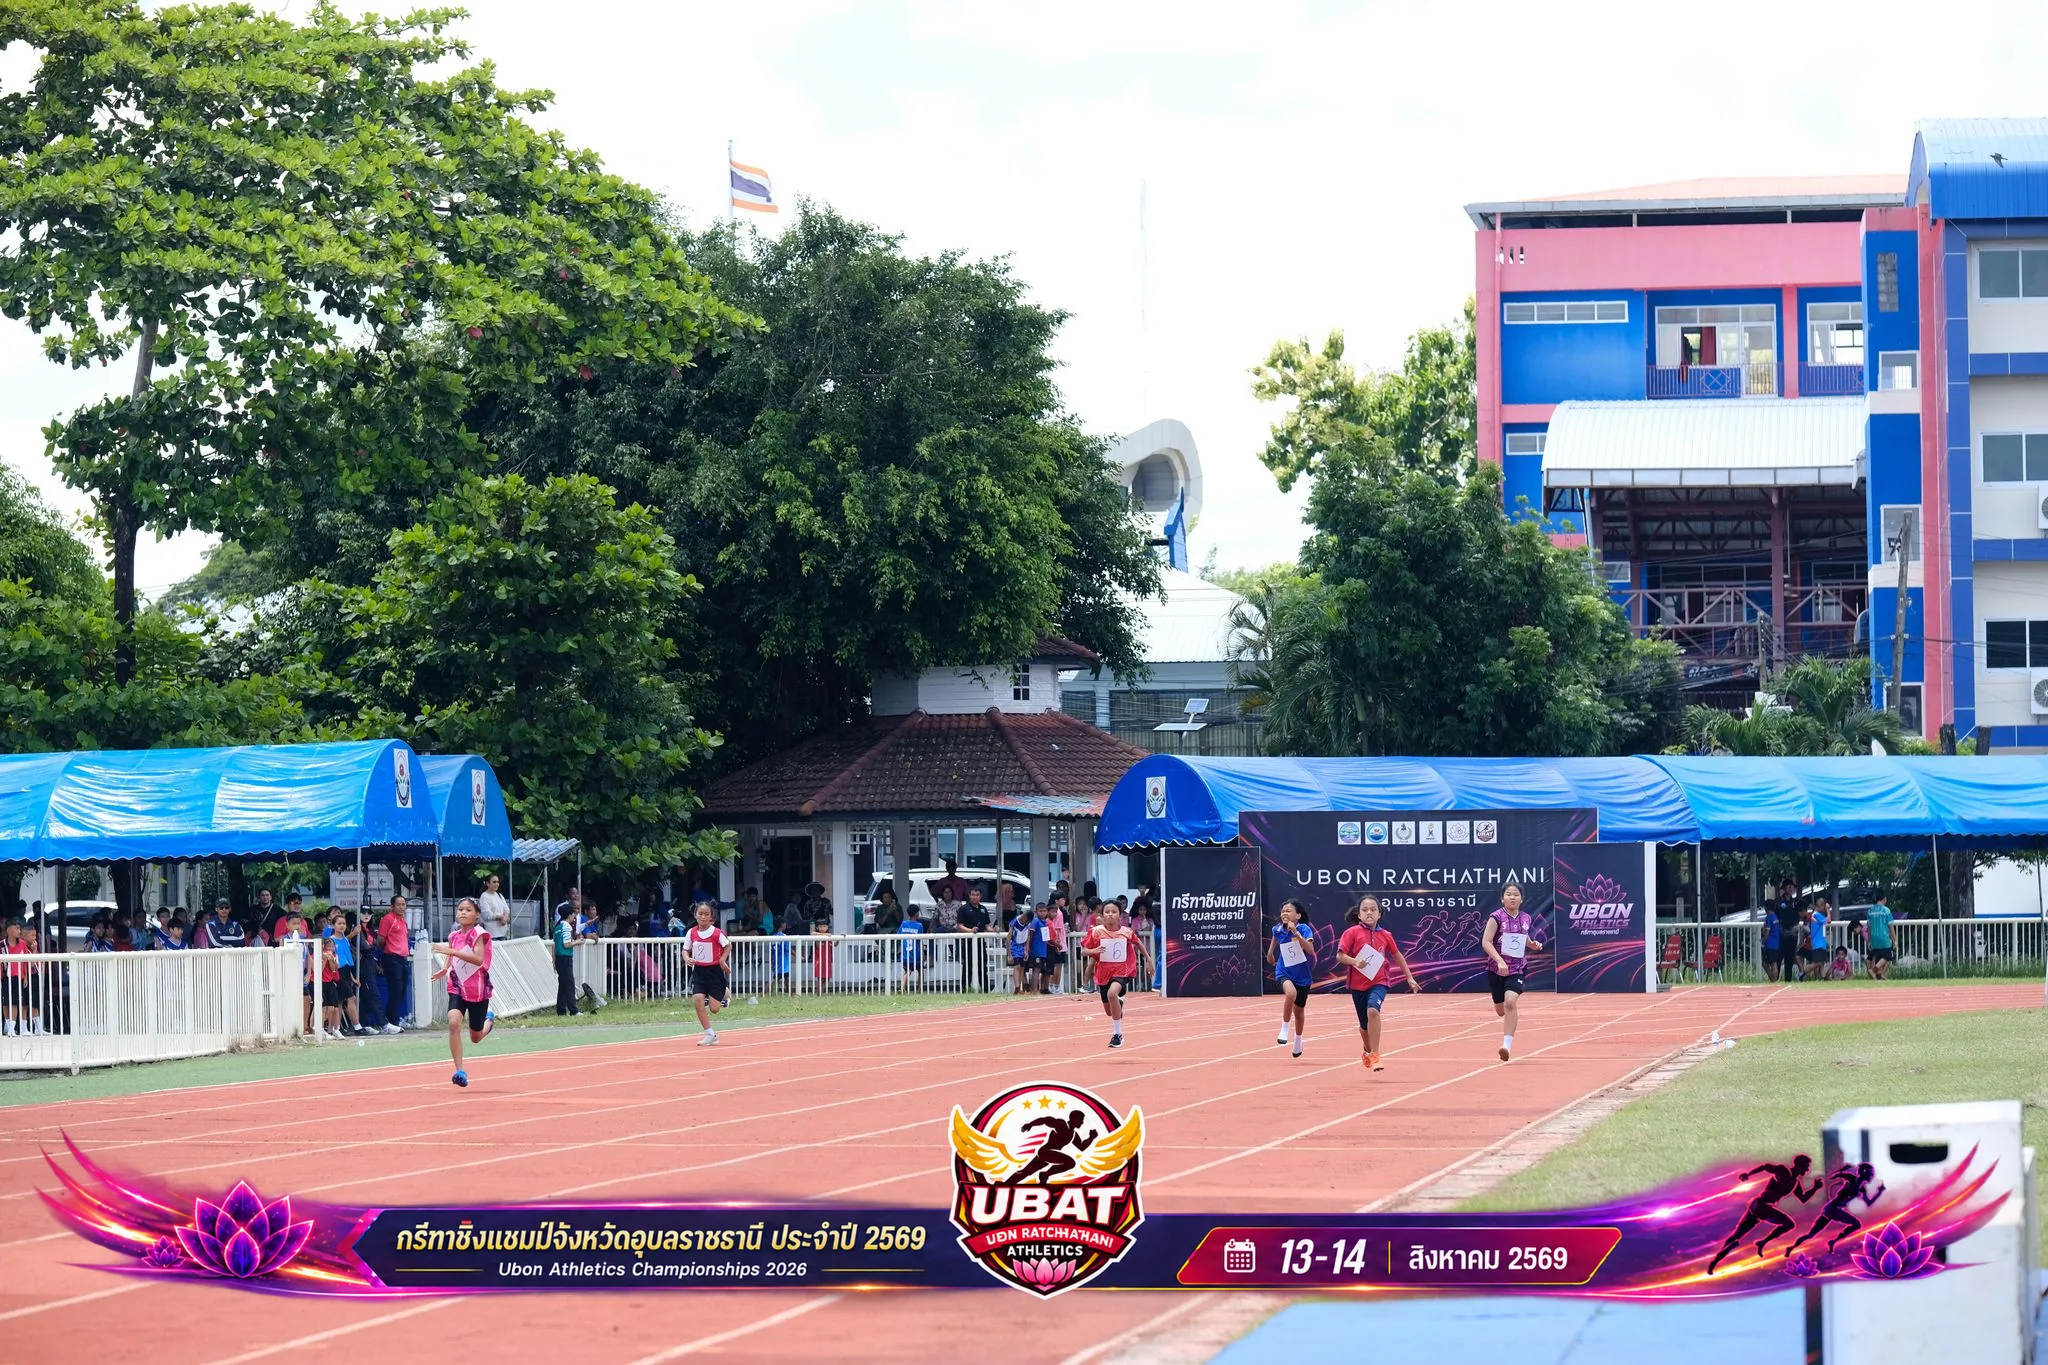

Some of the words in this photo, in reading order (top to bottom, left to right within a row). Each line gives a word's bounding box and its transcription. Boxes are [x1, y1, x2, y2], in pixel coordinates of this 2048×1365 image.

[1297, 869, 1370, 885] UBON
[1383, 867, 1545, 884] RATCHATHANI
[1381, 893, 1476, 912] อุบลราชธานี
[1182, 909, 1244, 923] จ.อุบลราชธานี
[1569, 903, 1633, 919] UBON
[1570, 919, 1631, 929] ATHLETICS
[1229, 932, 1246, 940] 2569
[1510, 935, 1520, 950] 3
[698, 945, 705, 960] 8
[1113, 942, 1121, 960] 6
[1287, 946, 1296, 958] 5
